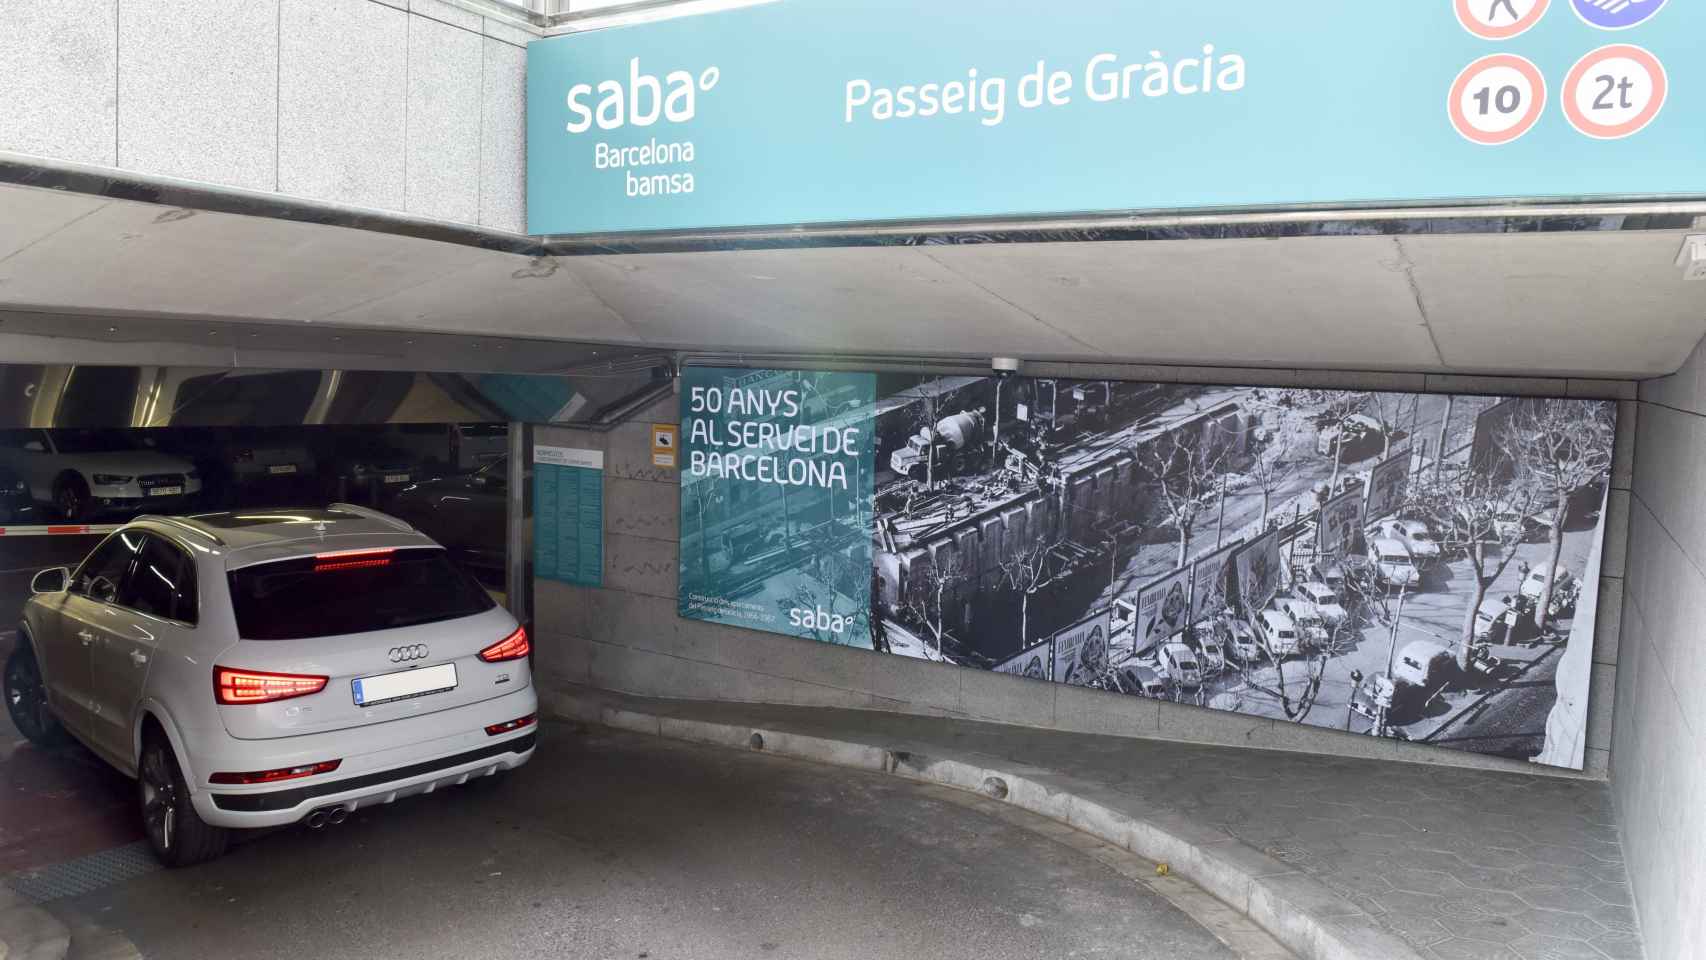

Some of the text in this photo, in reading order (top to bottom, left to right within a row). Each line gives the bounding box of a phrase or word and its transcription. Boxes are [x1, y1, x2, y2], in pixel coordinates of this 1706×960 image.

[845, 43, 1246, 127] Passeig de Gràcia
[1472, 85, 1521, 115] 10
[1591, 74, 1634, 110] 2t
[594, 137, 695, 170] Barcelona
[625, 170, 695, 197] bamsa
[690, 386, 799, 418] 50 ANYS
[690, 418, 860, 457] AL SERVEI DE
[690, 450, 848, 491] BARCELONA
